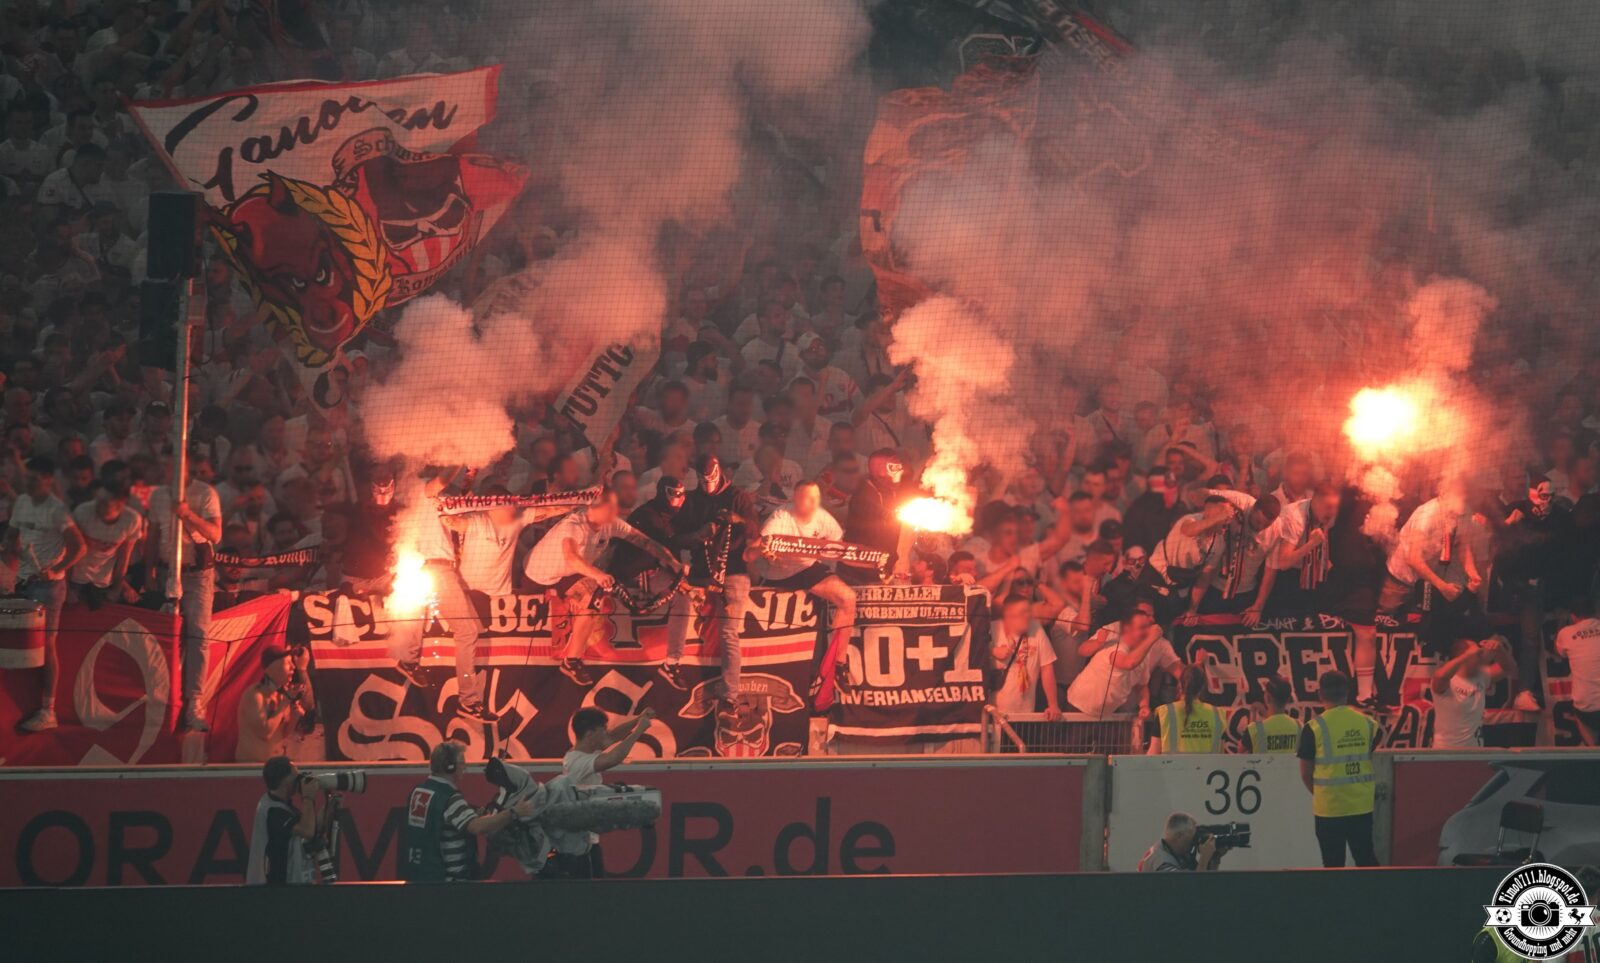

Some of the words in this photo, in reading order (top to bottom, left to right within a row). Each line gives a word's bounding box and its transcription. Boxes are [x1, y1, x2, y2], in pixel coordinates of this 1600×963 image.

[894, 586, 942, 601] ALLEN
[920, 606, 965, 619] ULTRAS
[1204, 769, 1262, 815] 36
